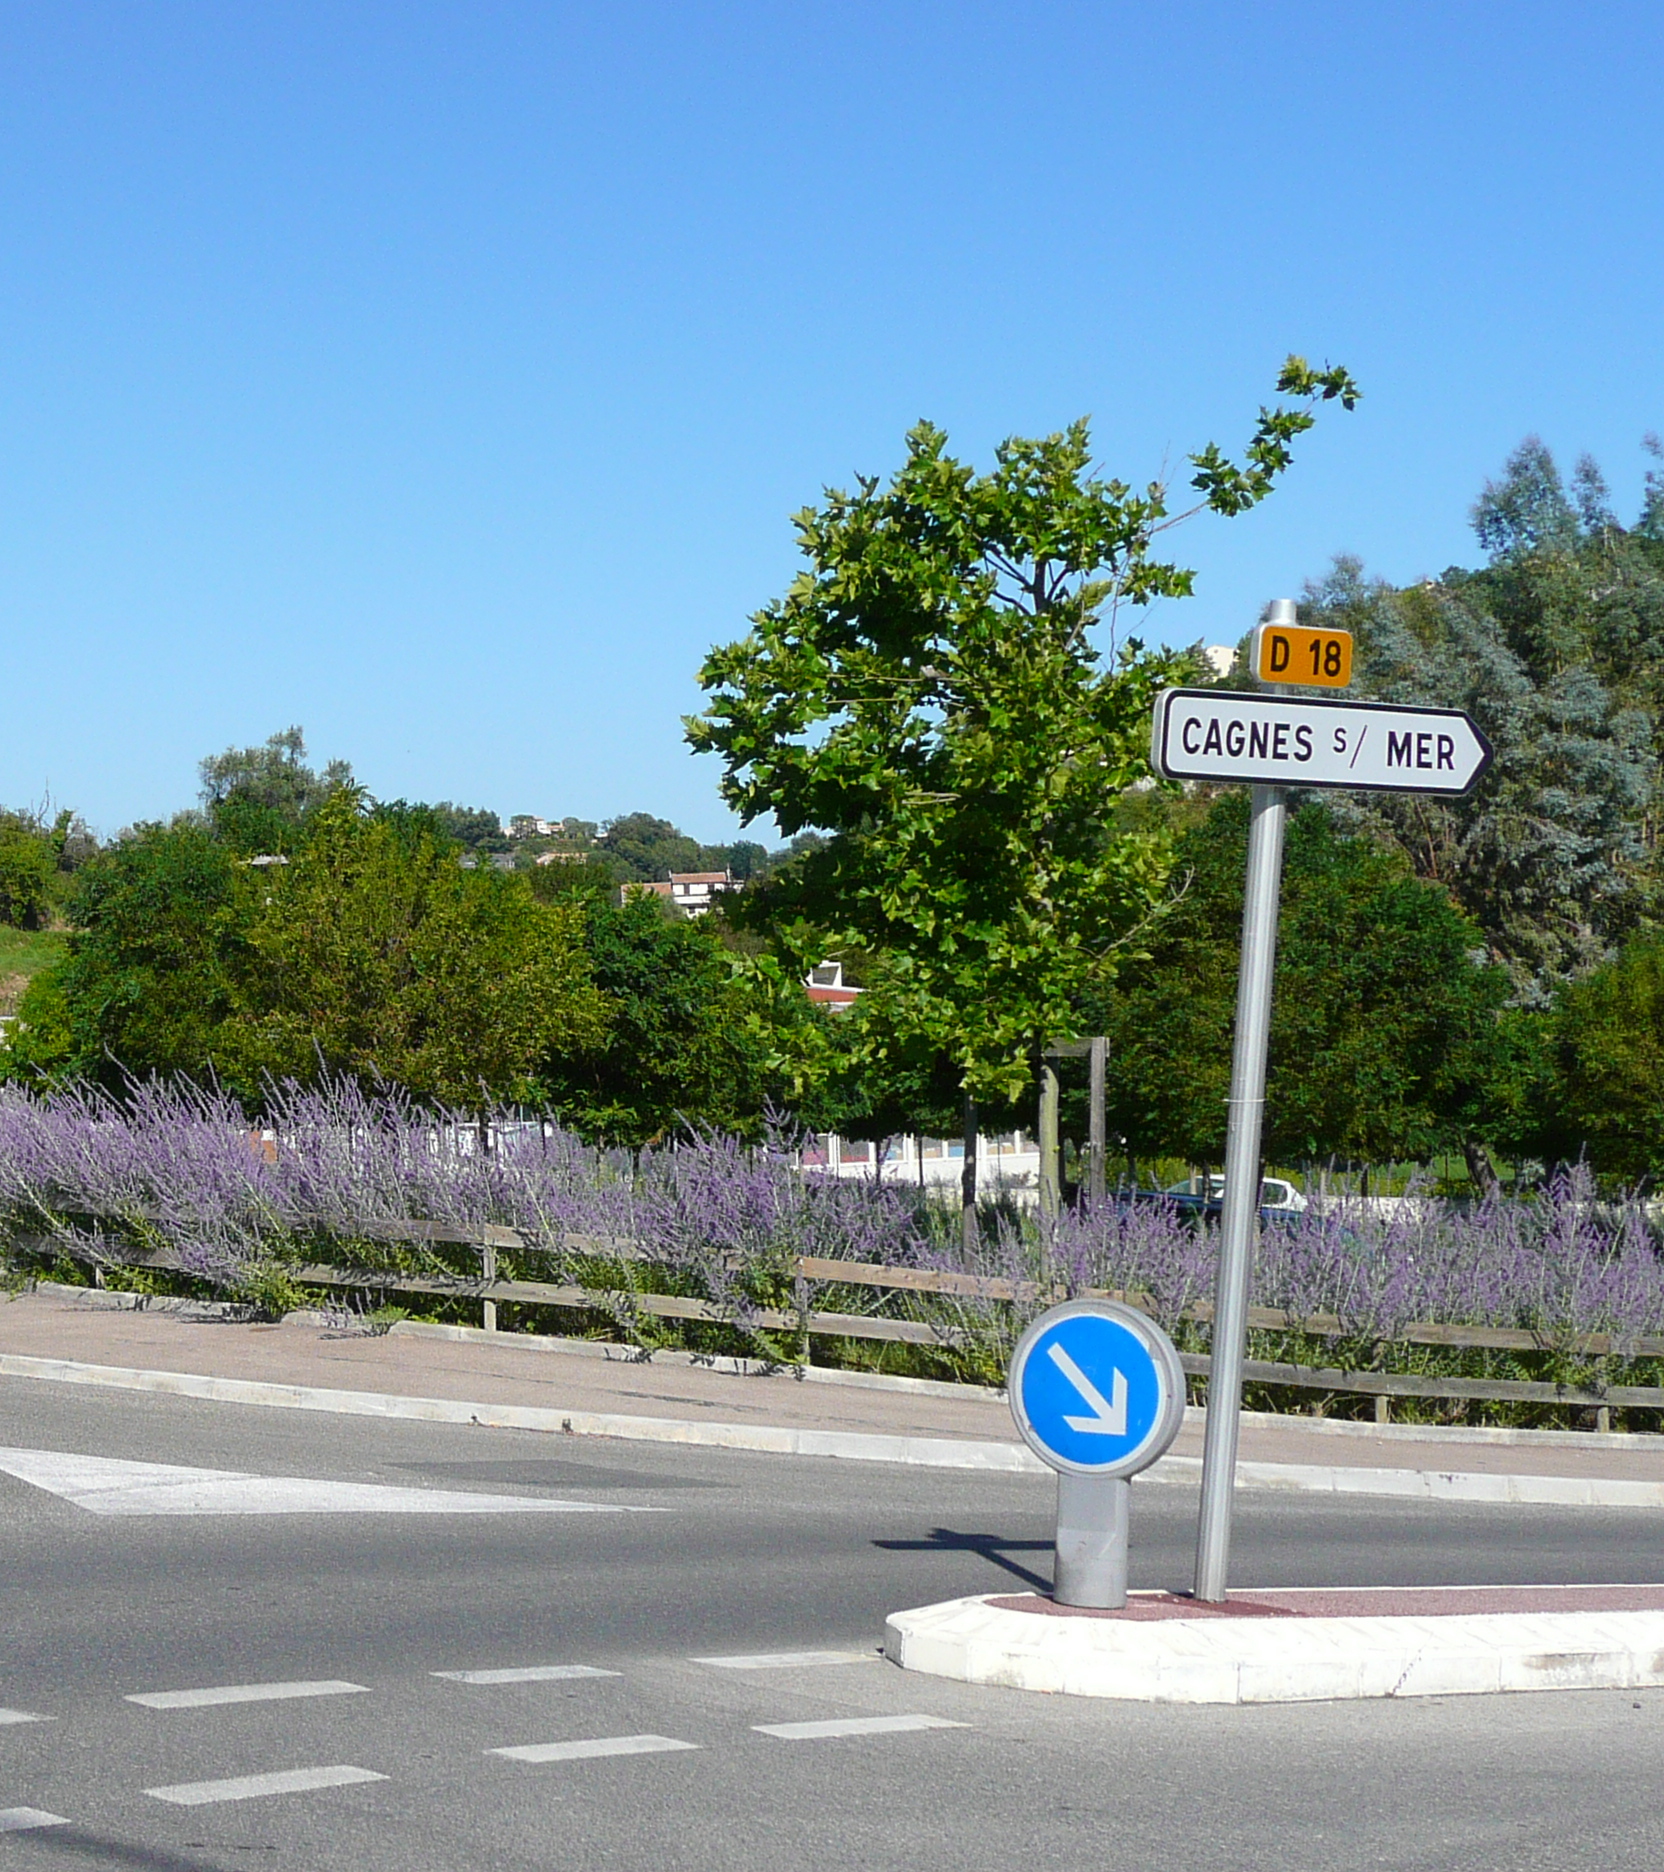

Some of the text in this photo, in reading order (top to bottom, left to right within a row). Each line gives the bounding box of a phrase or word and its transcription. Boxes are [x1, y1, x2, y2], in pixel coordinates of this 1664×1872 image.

[1270, 635, 1342, 677] D 18
[1182, 717, 1314, 762] CAGNES
[1386, 731, 1455, 770] MER
